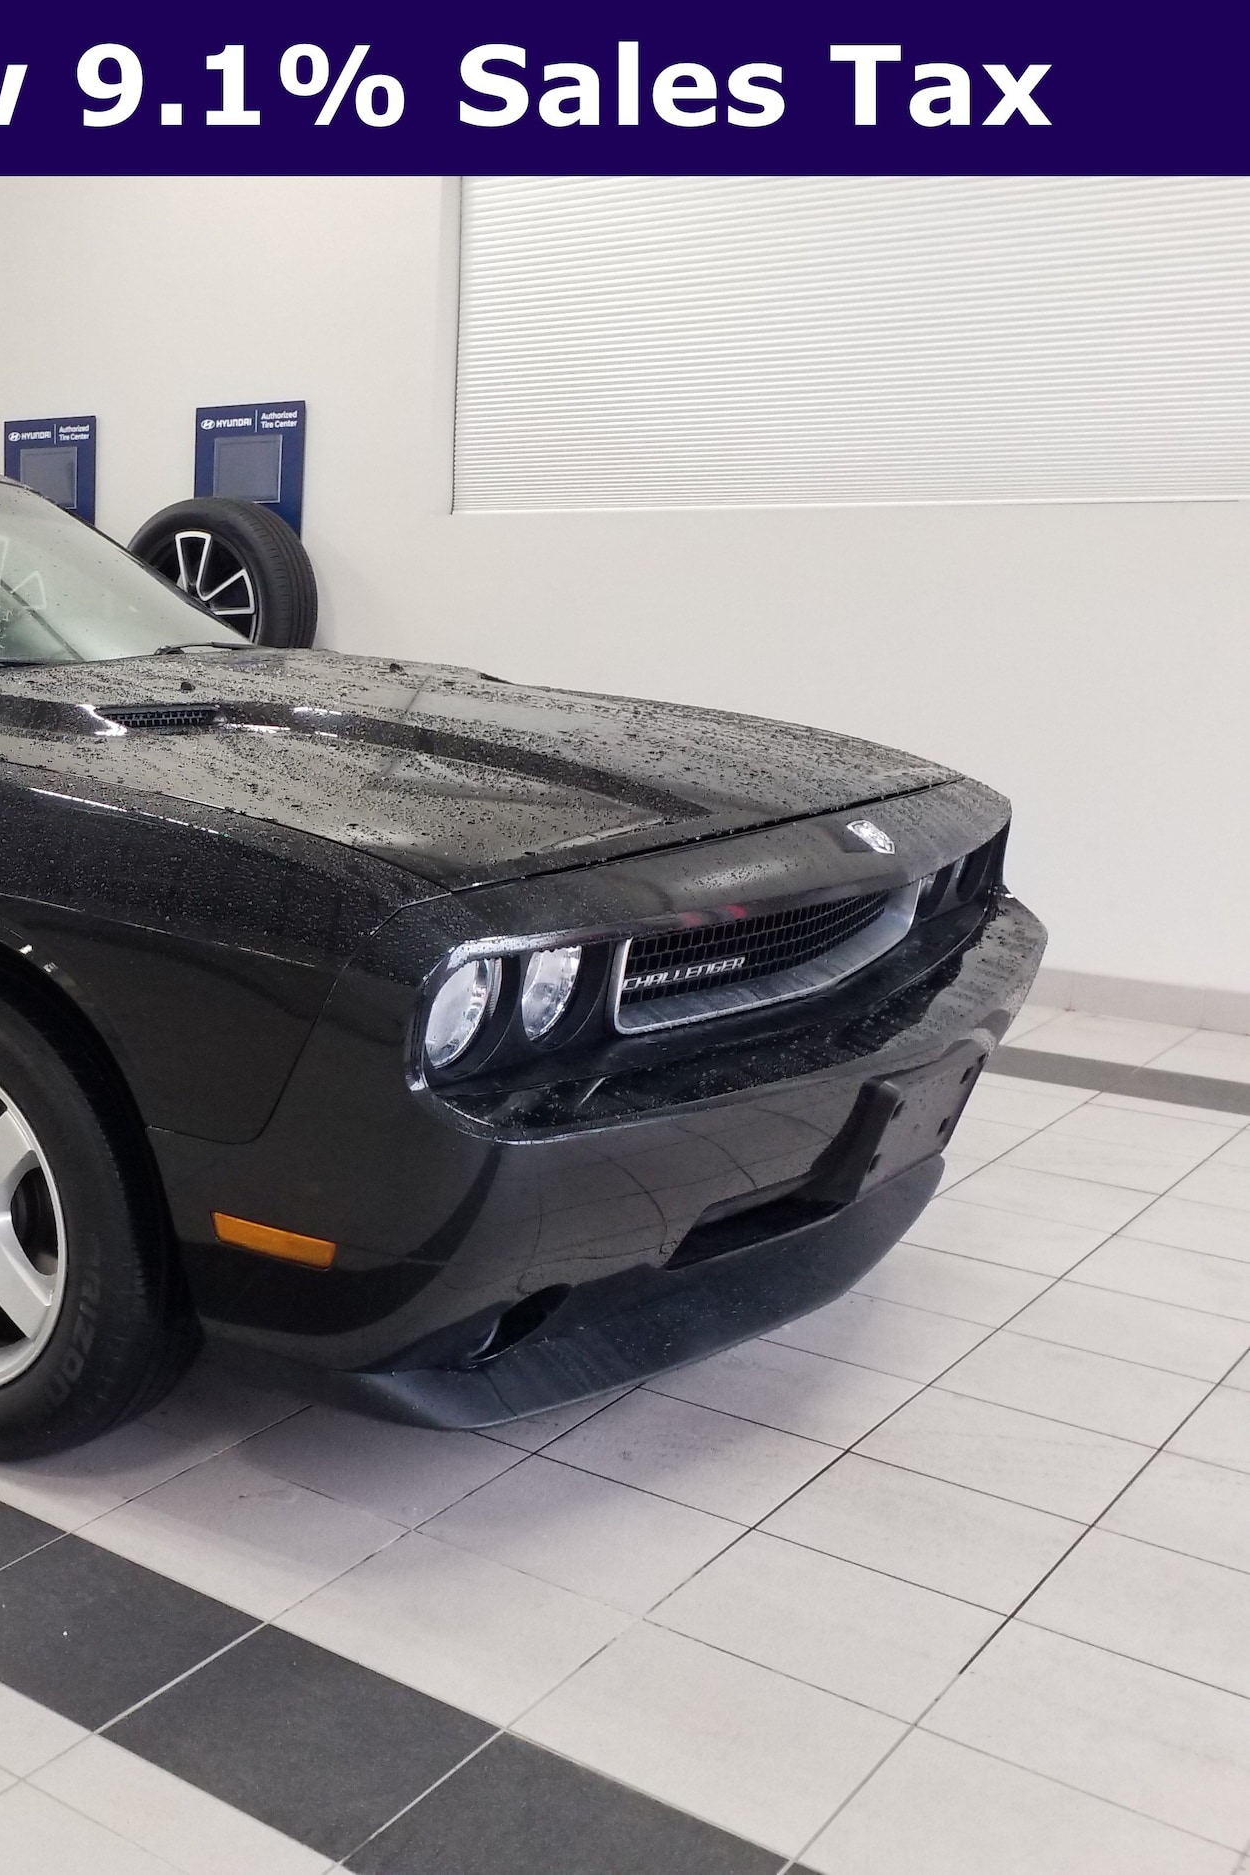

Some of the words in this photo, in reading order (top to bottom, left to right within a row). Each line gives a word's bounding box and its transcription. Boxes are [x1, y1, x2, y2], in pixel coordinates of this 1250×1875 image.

[261, 410, 298, 420] Authorized
[216, 418, 252, 428] HYUNDAI
[261, 421, 274, 429] Tire
[275, 420, 298, 428] Center
[58, 424, 90, 433] Authorized
[21, 431, 52, 441] HYUNDAI
[623, 956, 746, 992] CHALLENGER
